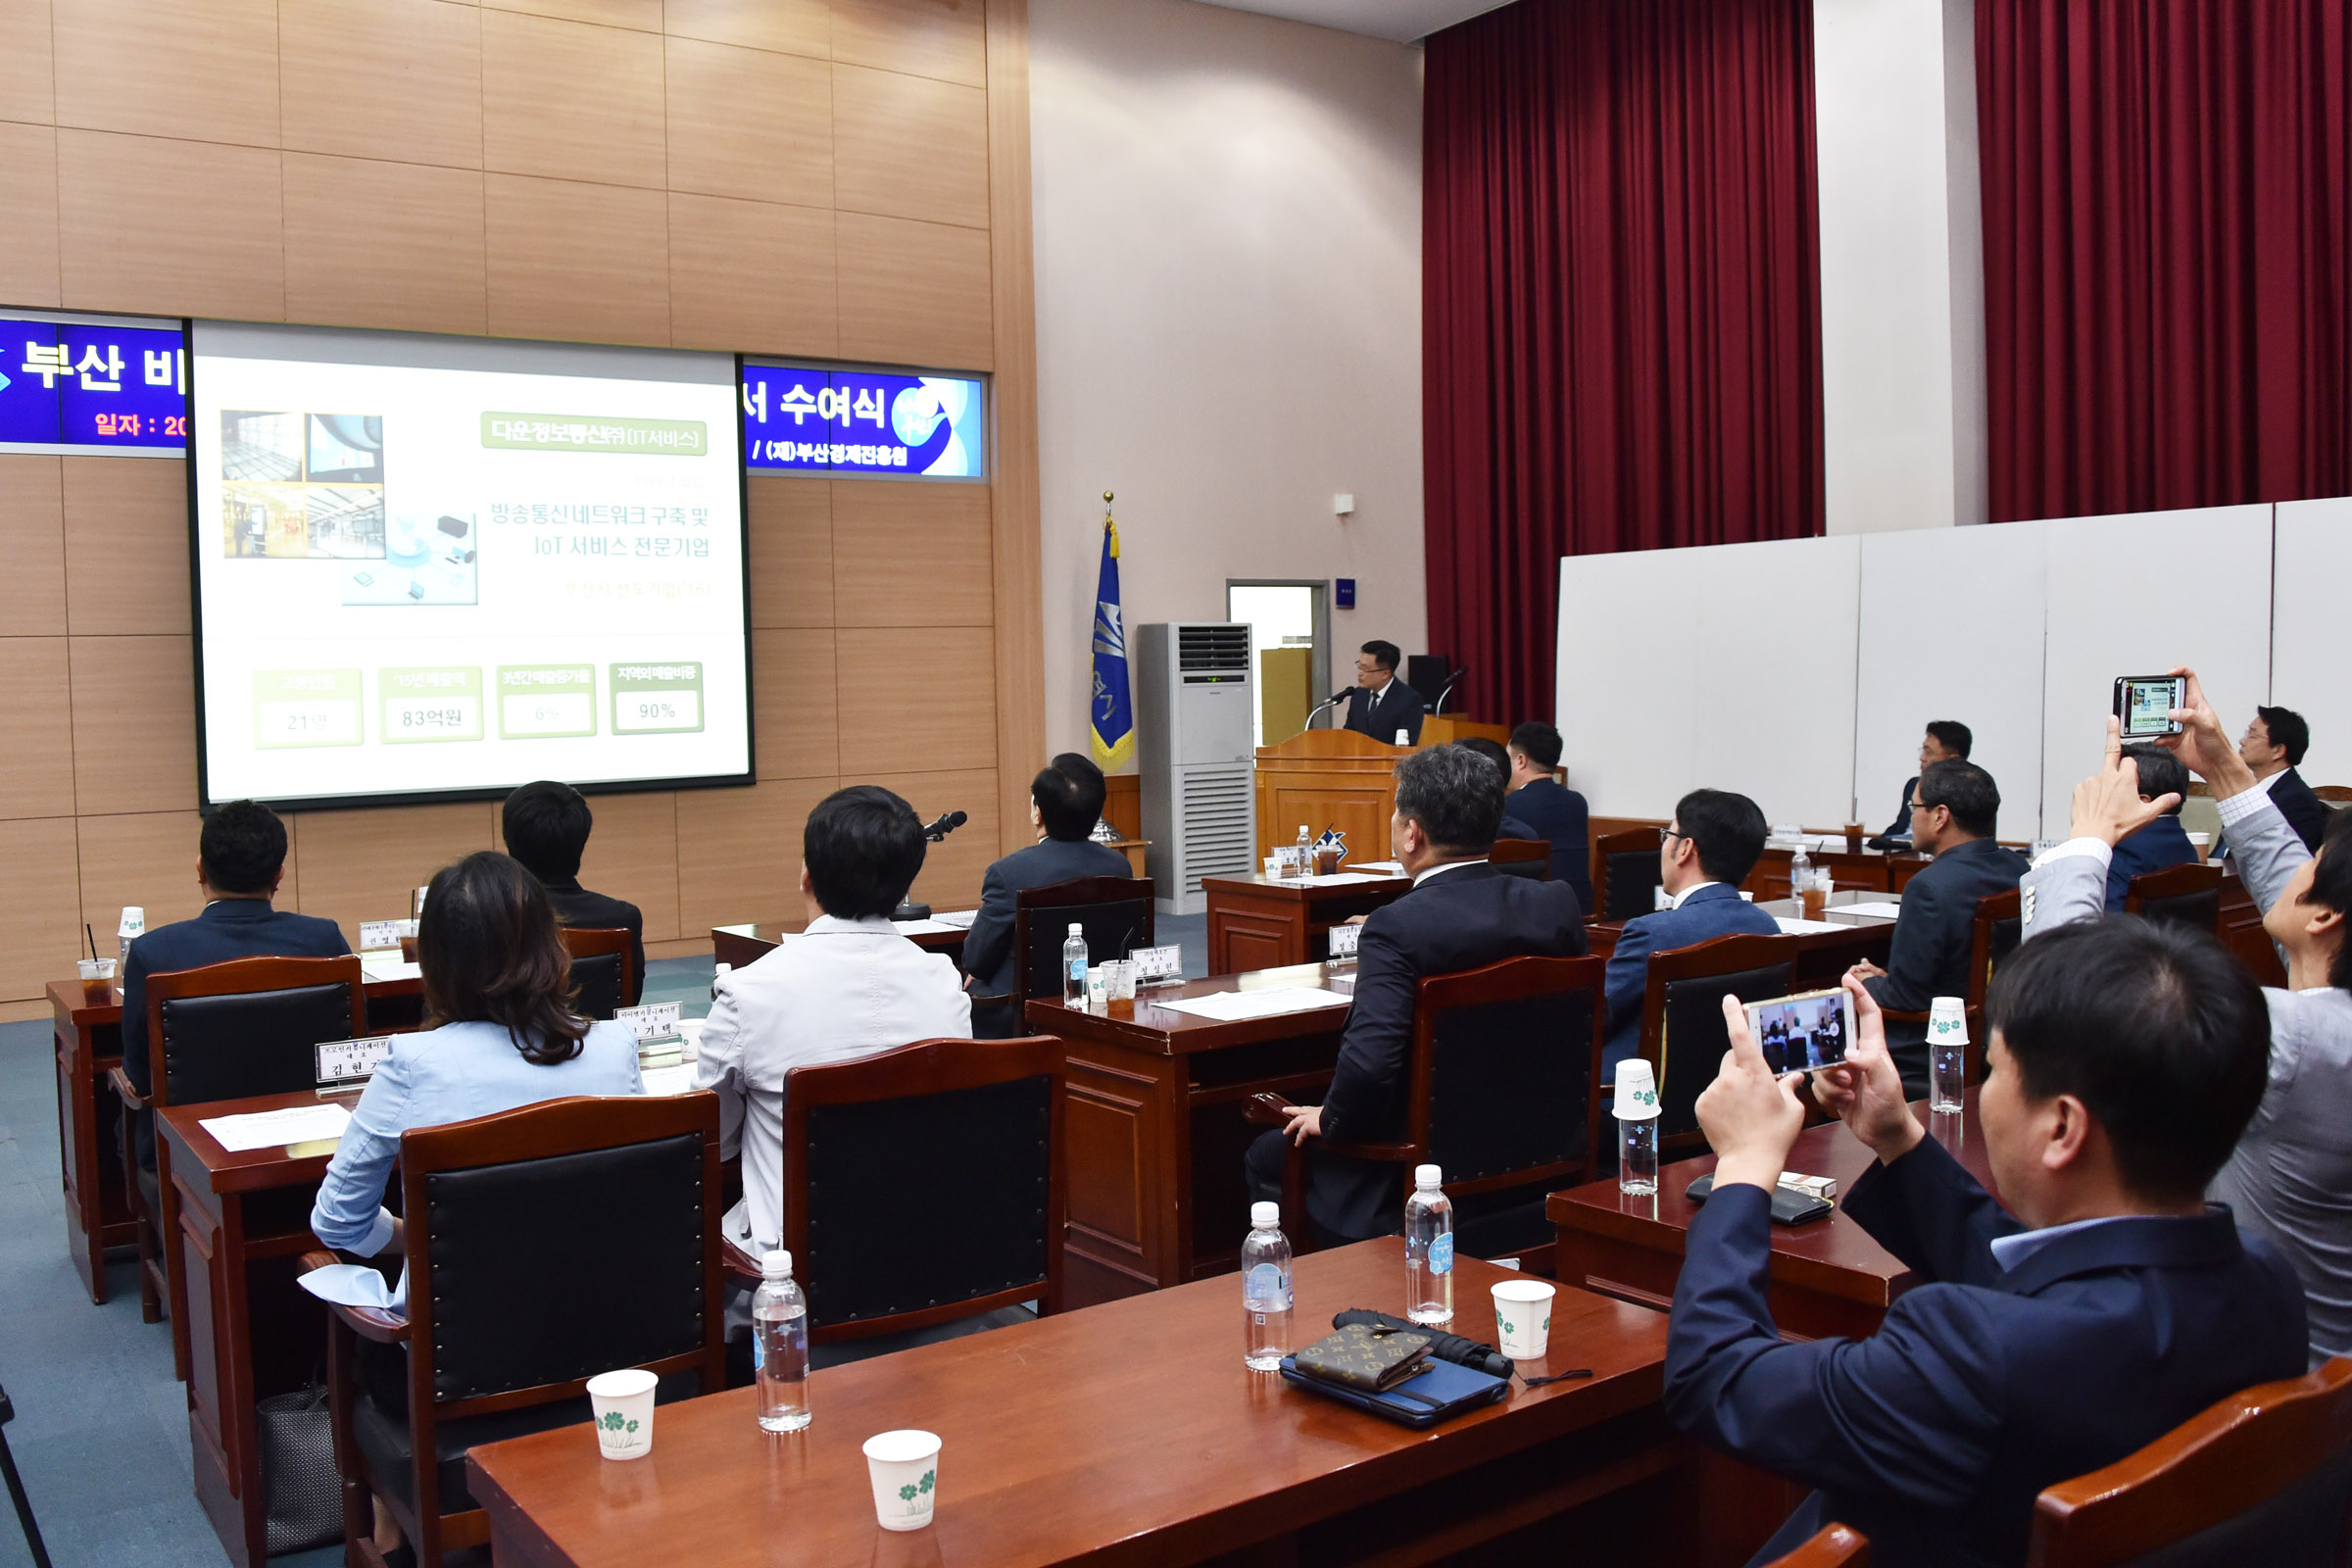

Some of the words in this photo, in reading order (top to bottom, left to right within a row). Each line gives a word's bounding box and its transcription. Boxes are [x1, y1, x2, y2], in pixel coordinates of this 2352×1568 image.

[22, 341, 124, 391] 부산
[780, 384, 886, 428] 수여식
[95, 413, 141, 436] 일자
[691, 508, 709, 527] 및
[534, 536, 564, 555] IoT
[570, 536, 628, 556] 서비스
[634, 537, 710, 558] 전문기업
[403, 710, 462, 727] 83억원
[639, 704, 675, 718] 90%
